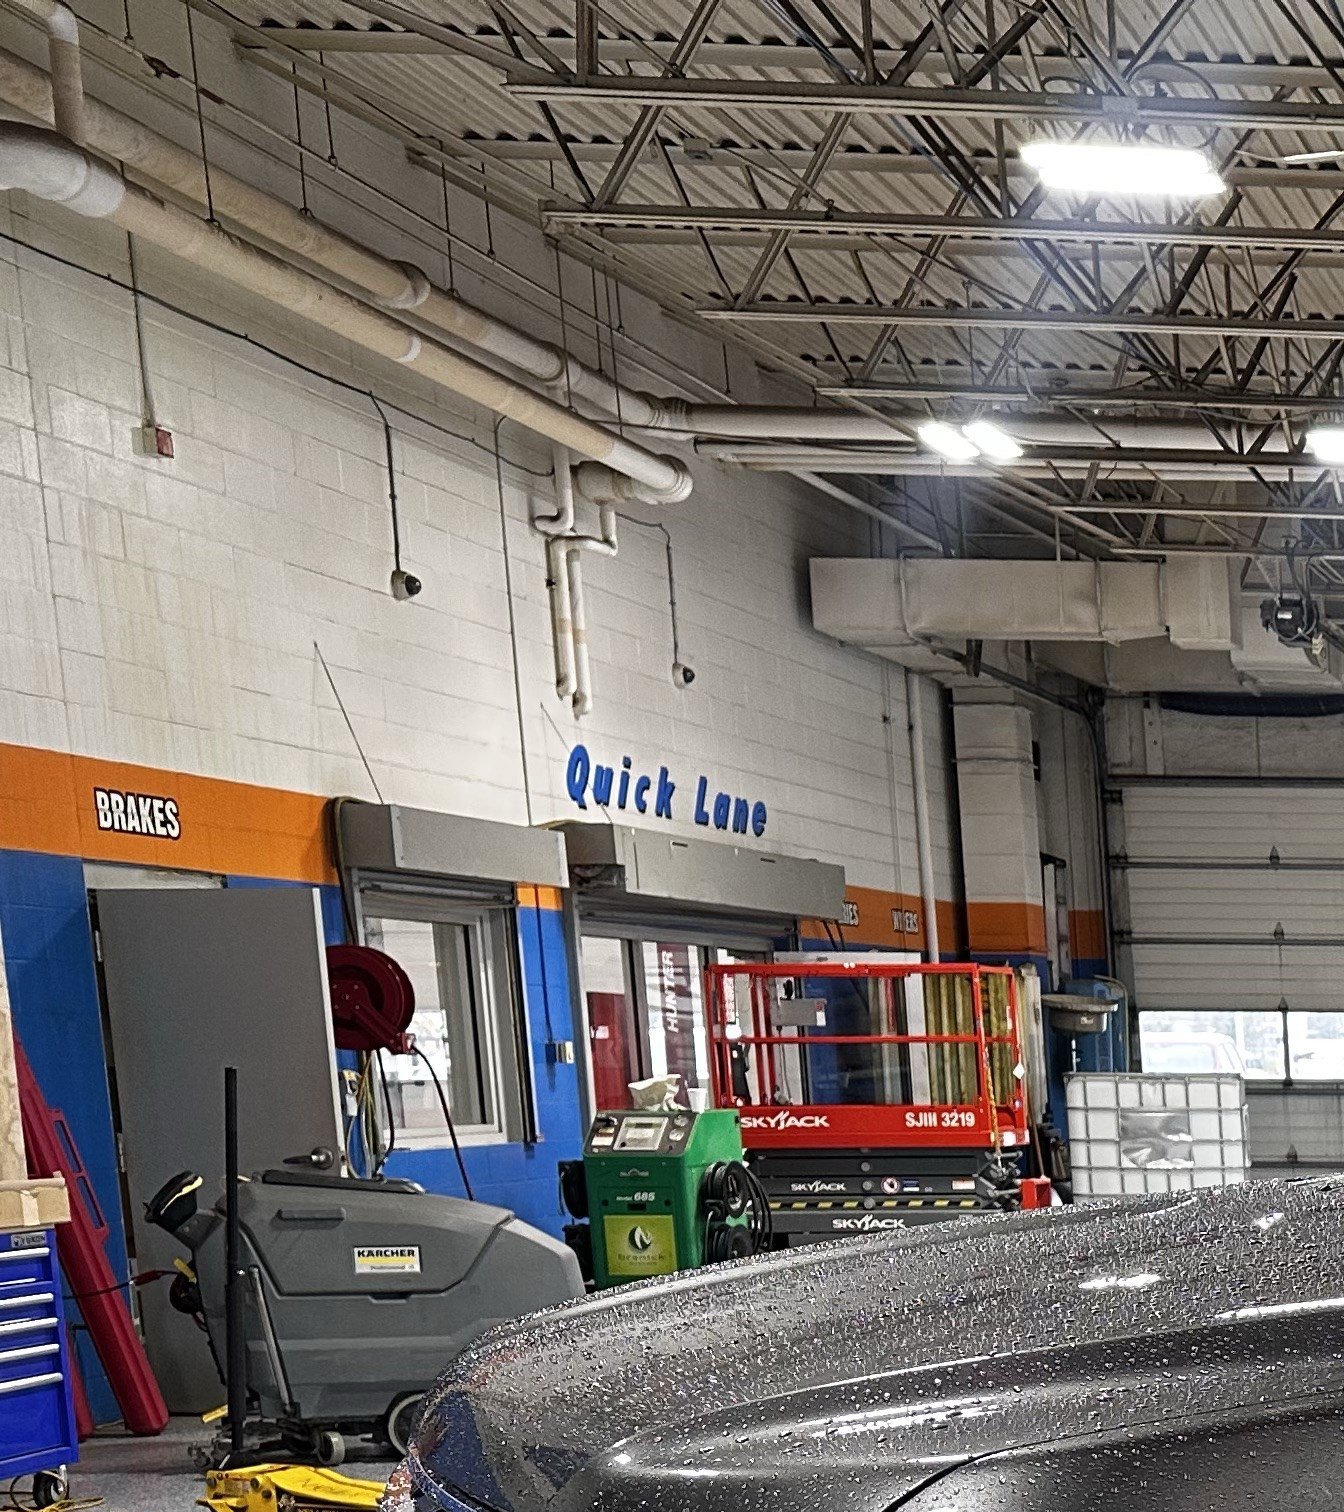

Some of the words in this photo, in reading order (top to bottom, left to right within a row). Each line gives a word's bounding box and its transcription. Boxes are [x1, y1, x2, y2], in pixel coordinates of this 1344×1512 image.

[566, 744, 675, 820] Quick
[694, 774, 767, 837] Lane
[94, 787, 181, 840] BRAKES
[661, 950, 679, 1033] HUNTER
[740, 1110, 830, 1131] SKYJACK
[941, 1111, 976, 1128] 3219
[791, 1180, 847, 1193] SKYJACK
[832, 1213, 907, 1231] SKYJACK
